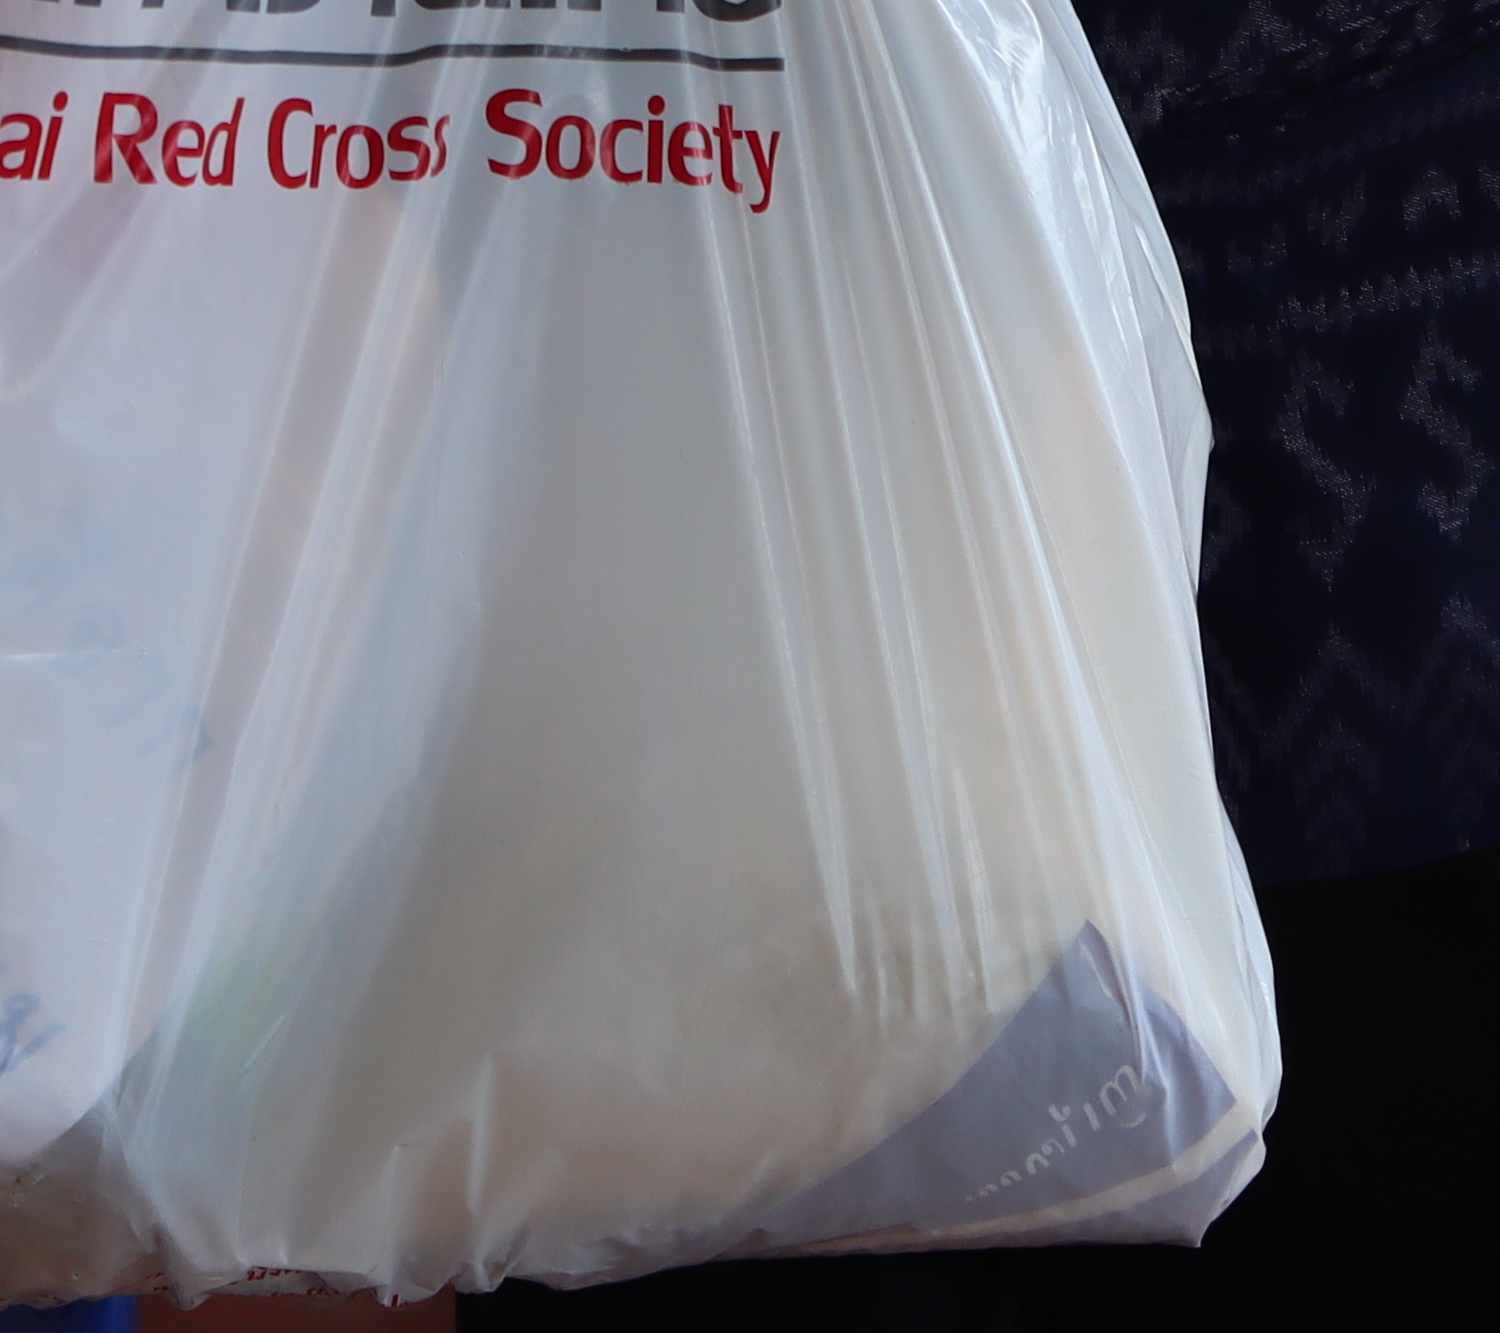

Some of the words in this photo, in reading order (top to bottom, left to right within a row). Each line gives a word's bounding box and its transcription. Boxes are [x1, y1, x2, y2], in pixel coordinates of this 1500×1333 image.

[93, 90, 246, 188] Red
[266, 96, 451, 190] Cross
[484, 87, 781, 214] Society
